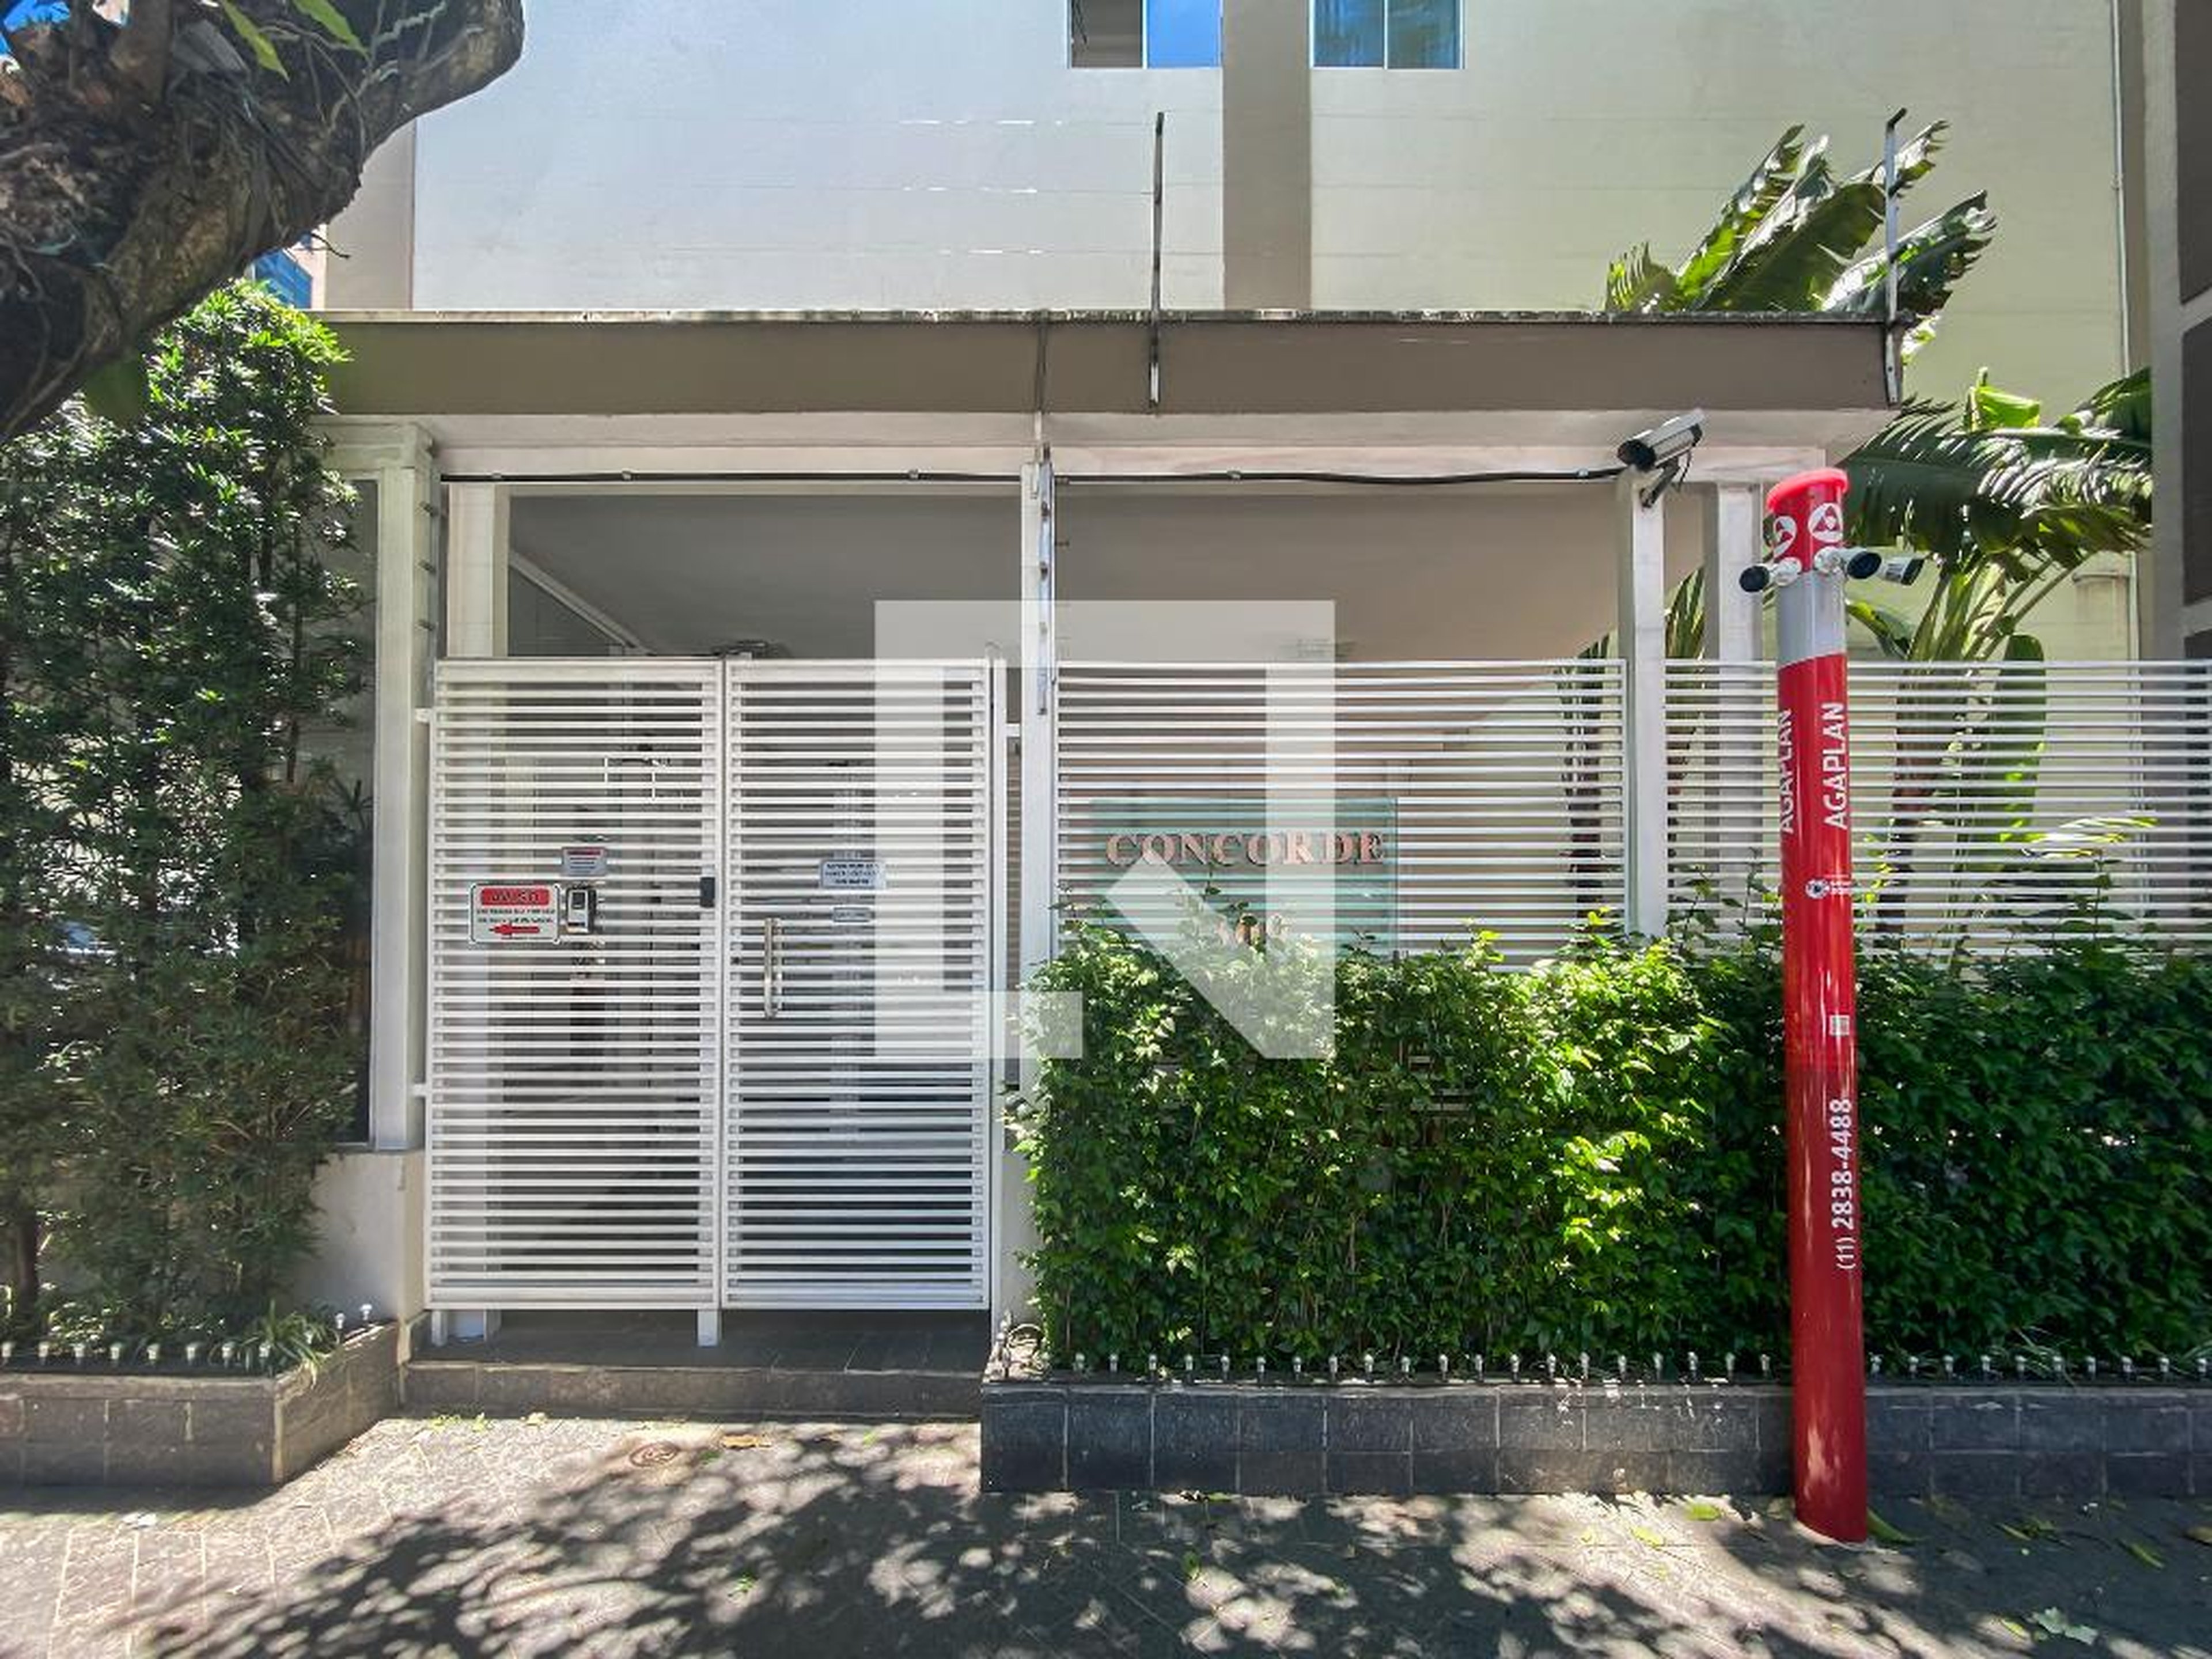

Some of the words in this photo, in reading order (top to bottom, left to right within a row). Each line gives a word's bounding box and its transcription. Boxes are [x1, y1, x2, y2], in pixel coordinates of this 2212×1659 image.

[1821, 702, 1847, 830] AGAPLAN
[1105, 831, 1385, 866] CONCORDE
[1830, 1099, 1854, 1230] 2838-4488
[1836, 1237, 1855, 1269] (11)
